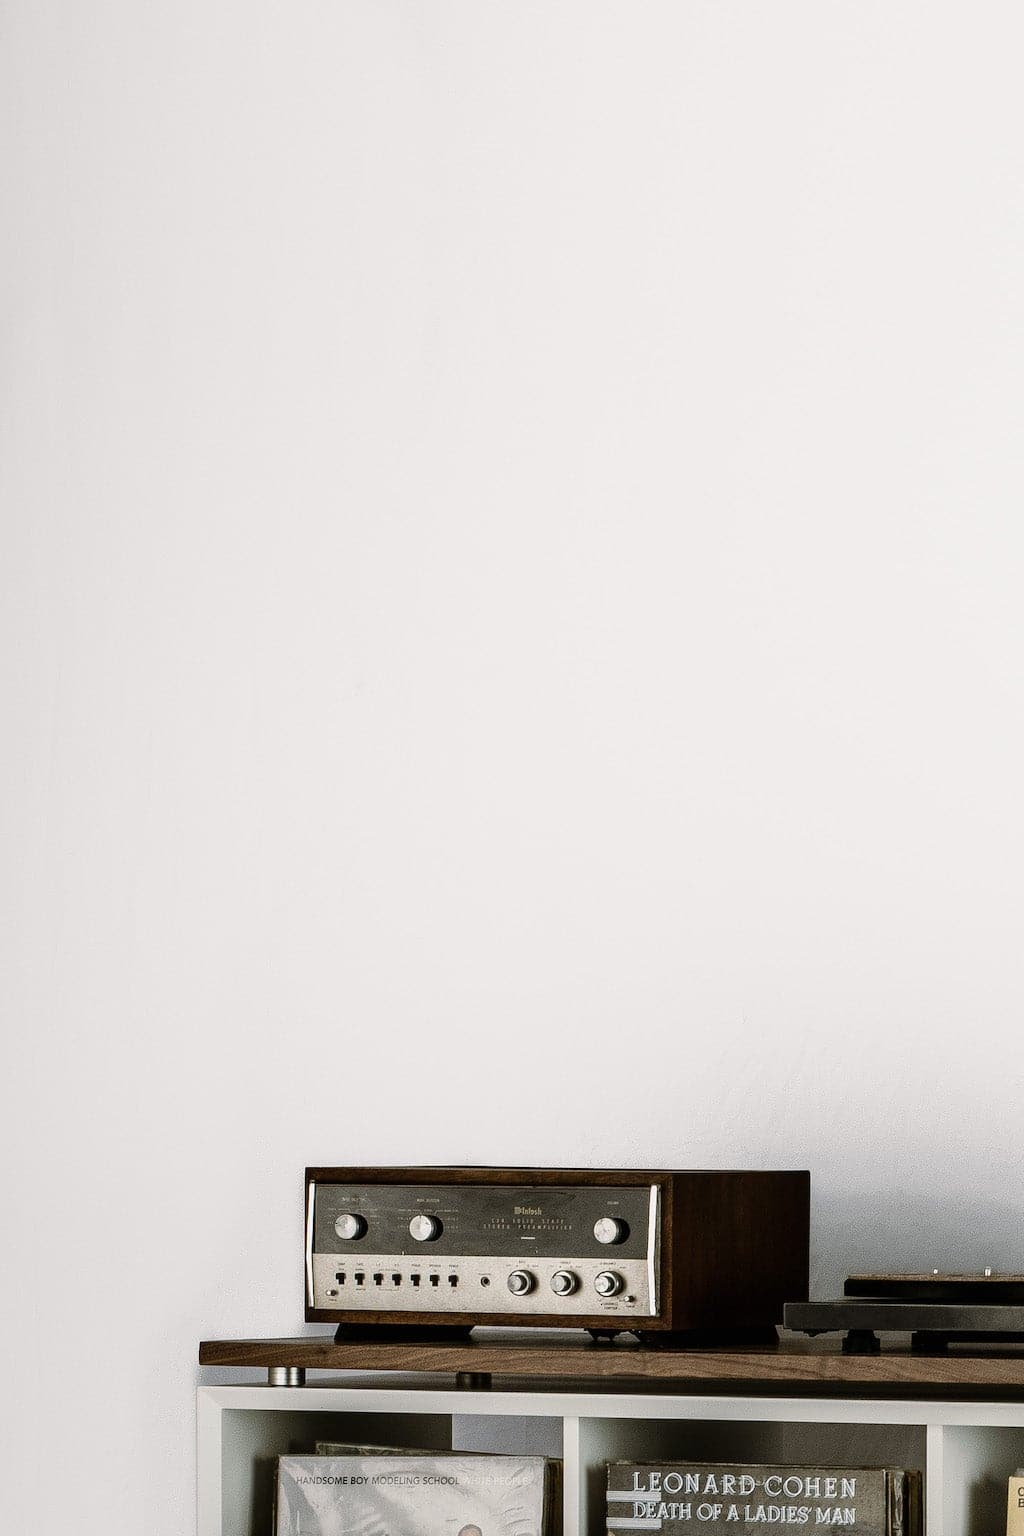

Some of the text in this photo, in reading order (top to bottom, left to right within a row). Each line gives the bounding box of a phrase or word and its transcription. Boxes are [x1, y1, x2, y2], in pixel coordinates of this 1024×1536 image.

[296, 1476, 347, 1486] HANDSOME
[350, 1476, 369, 1486] BOY
[371, 1476, 420, 1486] MODELING
[422, 1476, 460, 1486] SCHOOL
[632, 1471, 857, 1499] LEONARD COHEN
[633, 1501, 692, 1521] DEATH
[696, 1503, 723, 1522] OF
[726, 1504, 740, 1522] A
[815, 1507, 857, 1526] MAN
